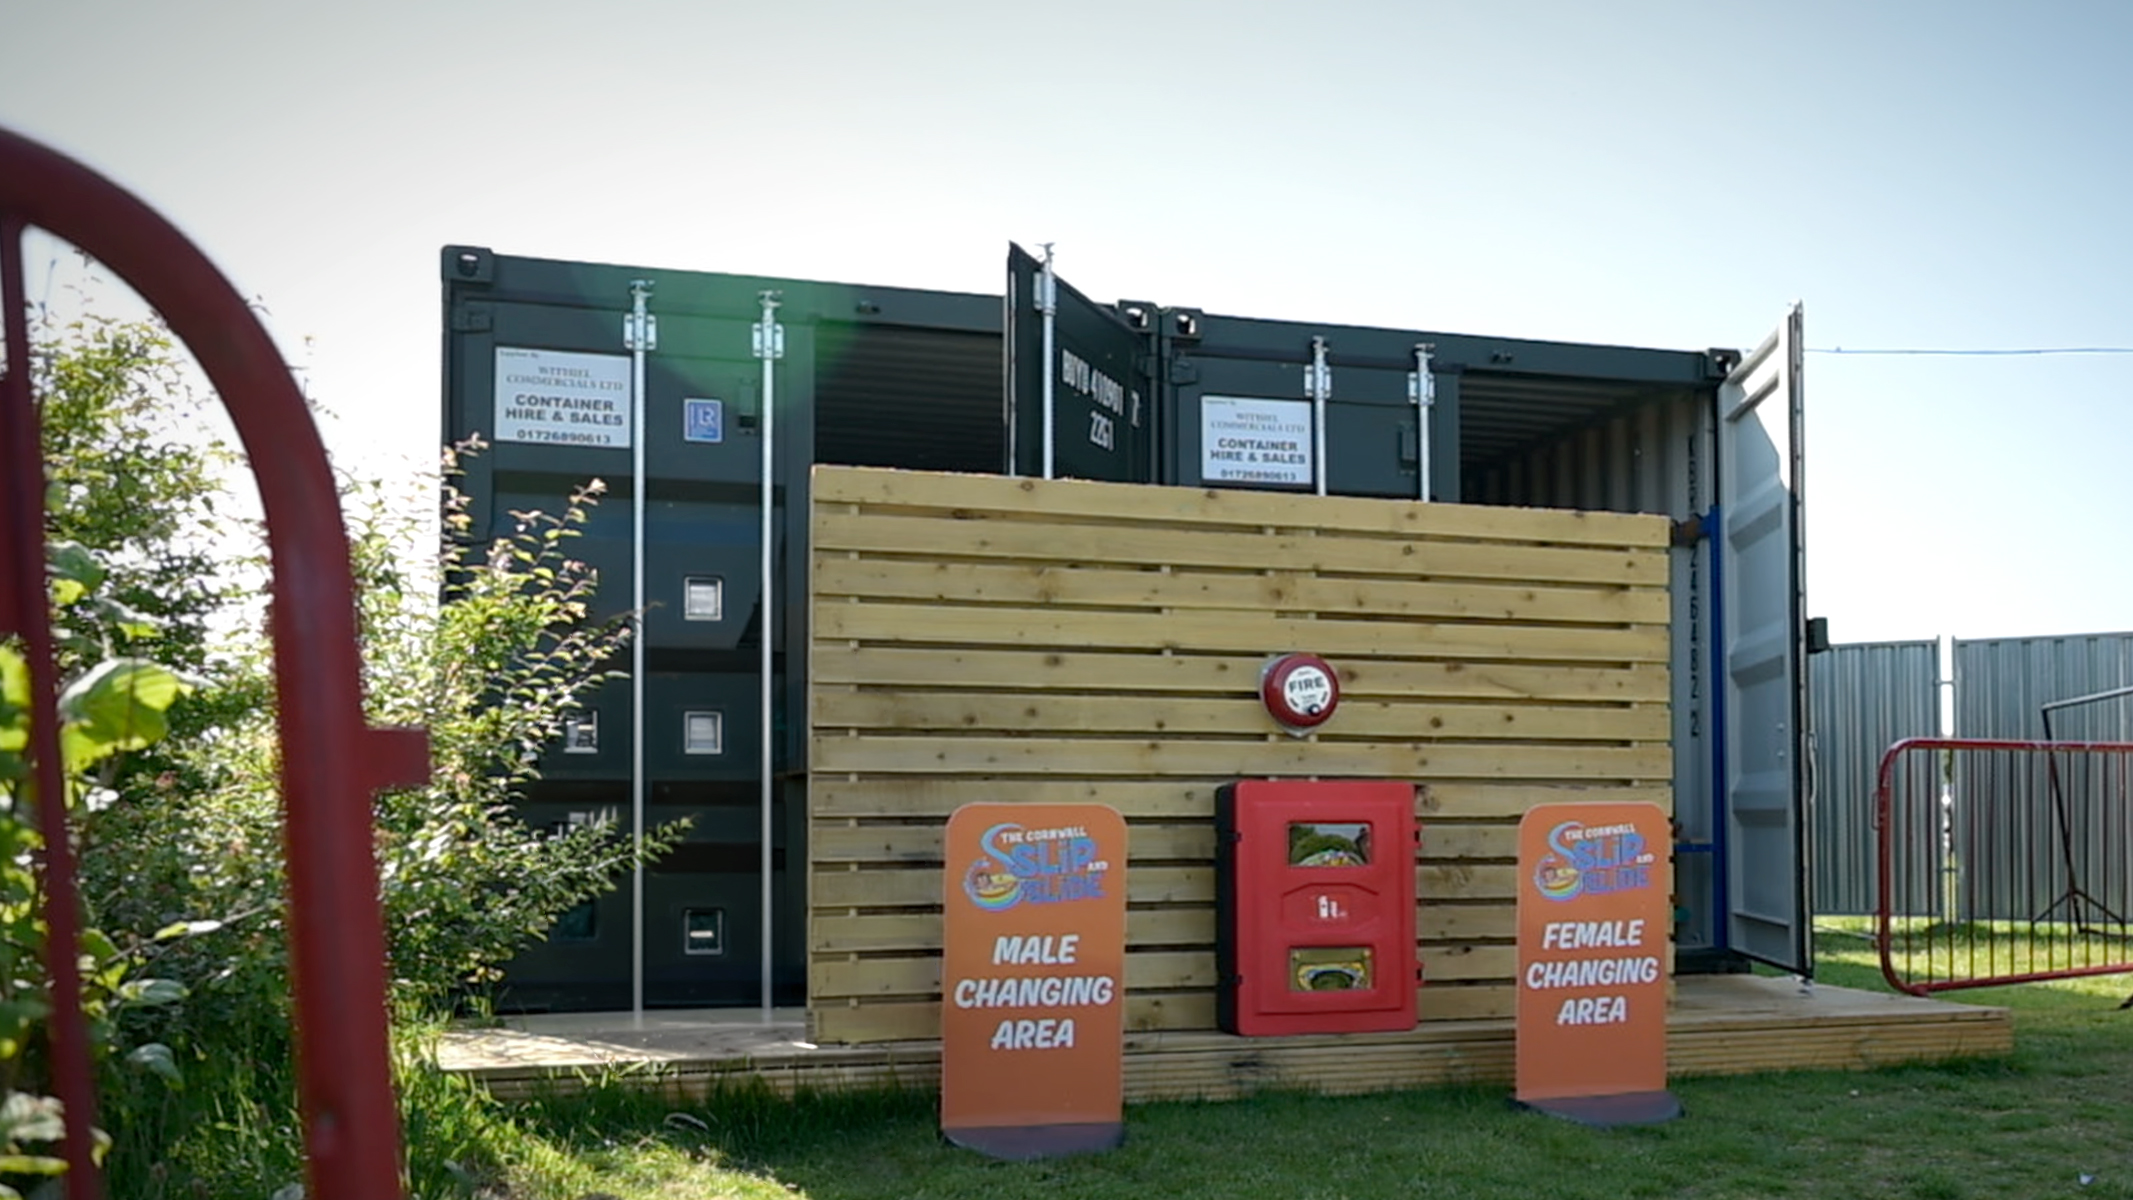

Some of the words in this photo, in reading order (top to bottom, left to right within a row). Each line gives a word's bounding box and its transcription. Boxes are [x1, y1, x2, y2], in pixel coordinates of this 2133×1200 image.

[506, 374, 597, 389] COMMERCIALS
[600, 380, 624, 391] LTD
[515, 394, 614, 411] CONTAINER
[505, 407, 547, 421] HIRE
[552, 411, 564, 422] &
[570, 412, 624, 426] SALES
[1218, 438, 1298, 451] CONTAINER
[1210, 450, 1243, 462] HIRE
[1248, 452, 1257, 462] &
[1262, 452, 1306, 464] SALES
[1288, 676, 1326, 693] FIRE
[1001, 831, 1023, 843] THE
[1026, 826, 1088, 842] CORNWALL
[1564, 829, 1583, 840] THE
[1585, 823, 1636, 839] CORNWALL
[1003, 837, 1097, 878] SLIP
[1569, 832, 1646, 871] SLIP
[1087, 861, 1109, 872] AND
[1542, 918, 1645, 950] FEMALE
[992, 934, 1080, 966] MALE
[1526, 956, 1659, 990] CHANGING
[955, 976, 1114, 1009] CHANGING
[1557, 996, 1627, 1026] AREA
[991, 1018, 1075, 1050] AREA
